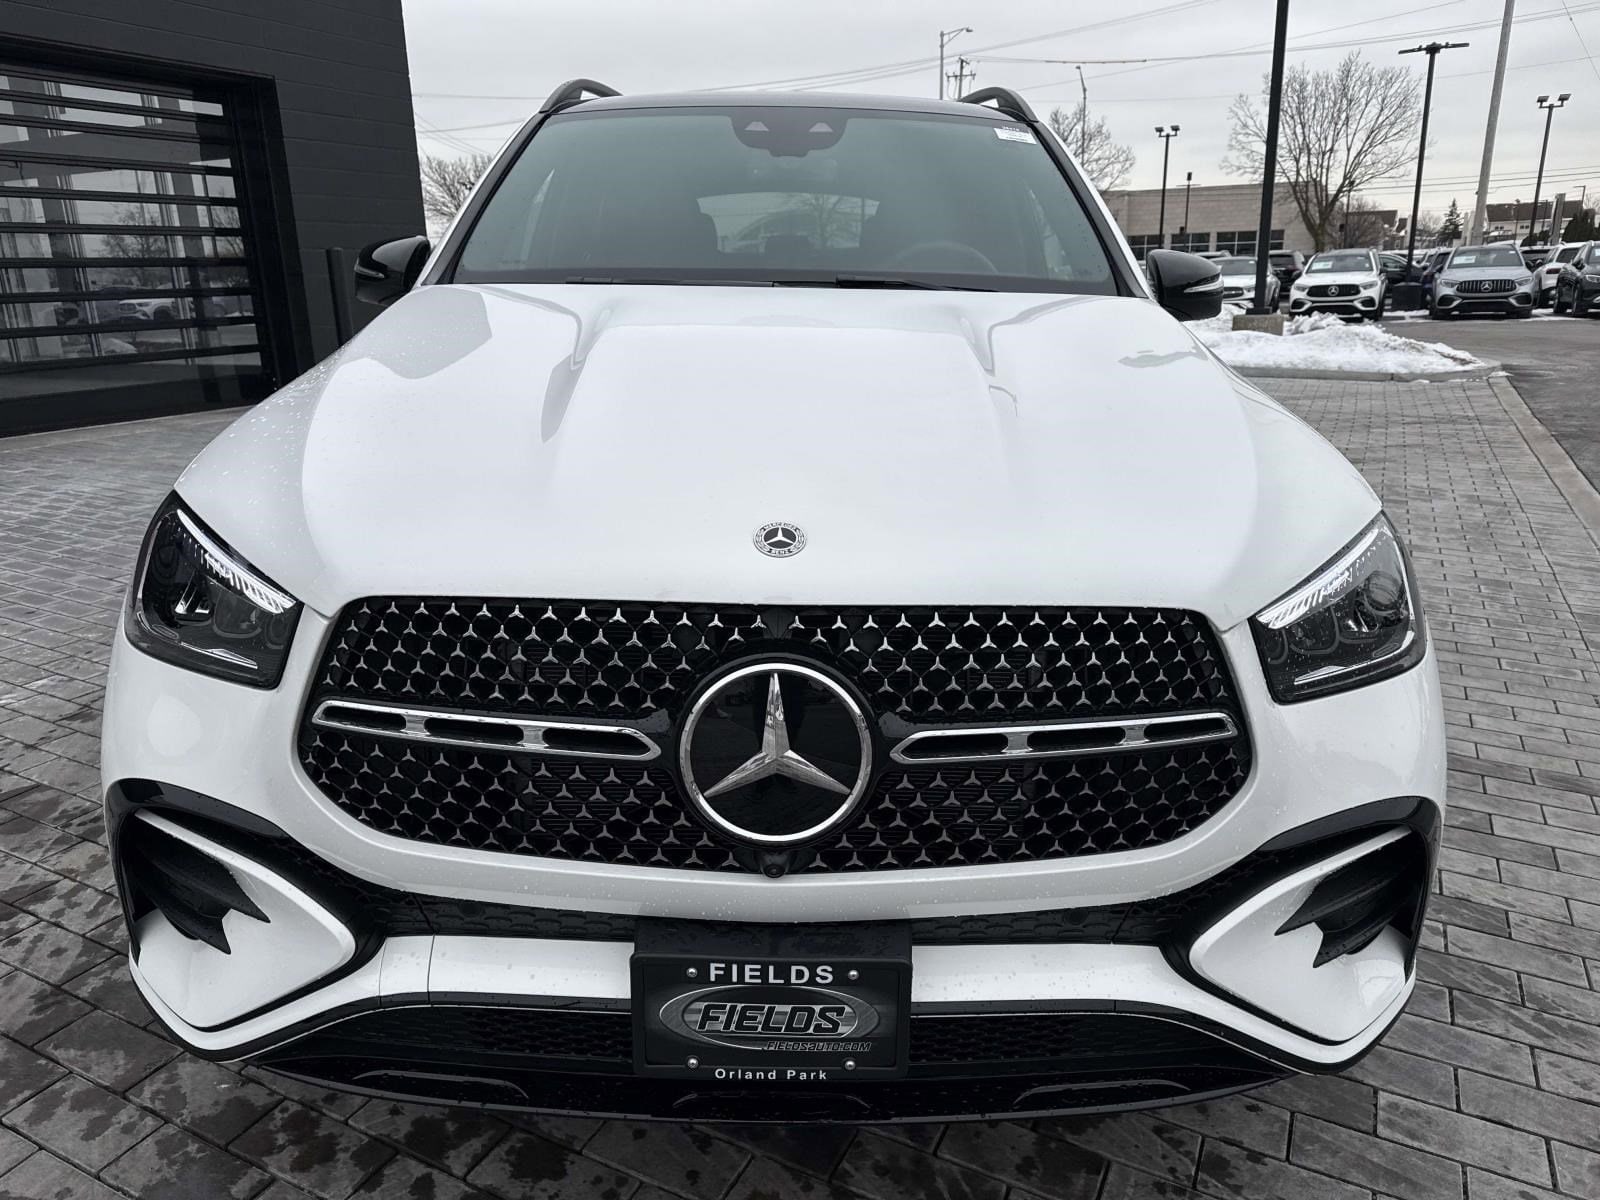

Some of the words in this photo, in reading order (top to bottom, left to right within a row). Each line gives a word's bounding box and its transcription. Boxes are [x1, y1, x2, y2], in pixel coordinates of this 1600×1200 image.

[709, 962, 834, 984] FIELDS
[697, 1002, 847, 1035] FIELDS
[714, 1068, 777, 1080] Orland
[786, 1069, 828, 1081] Park
